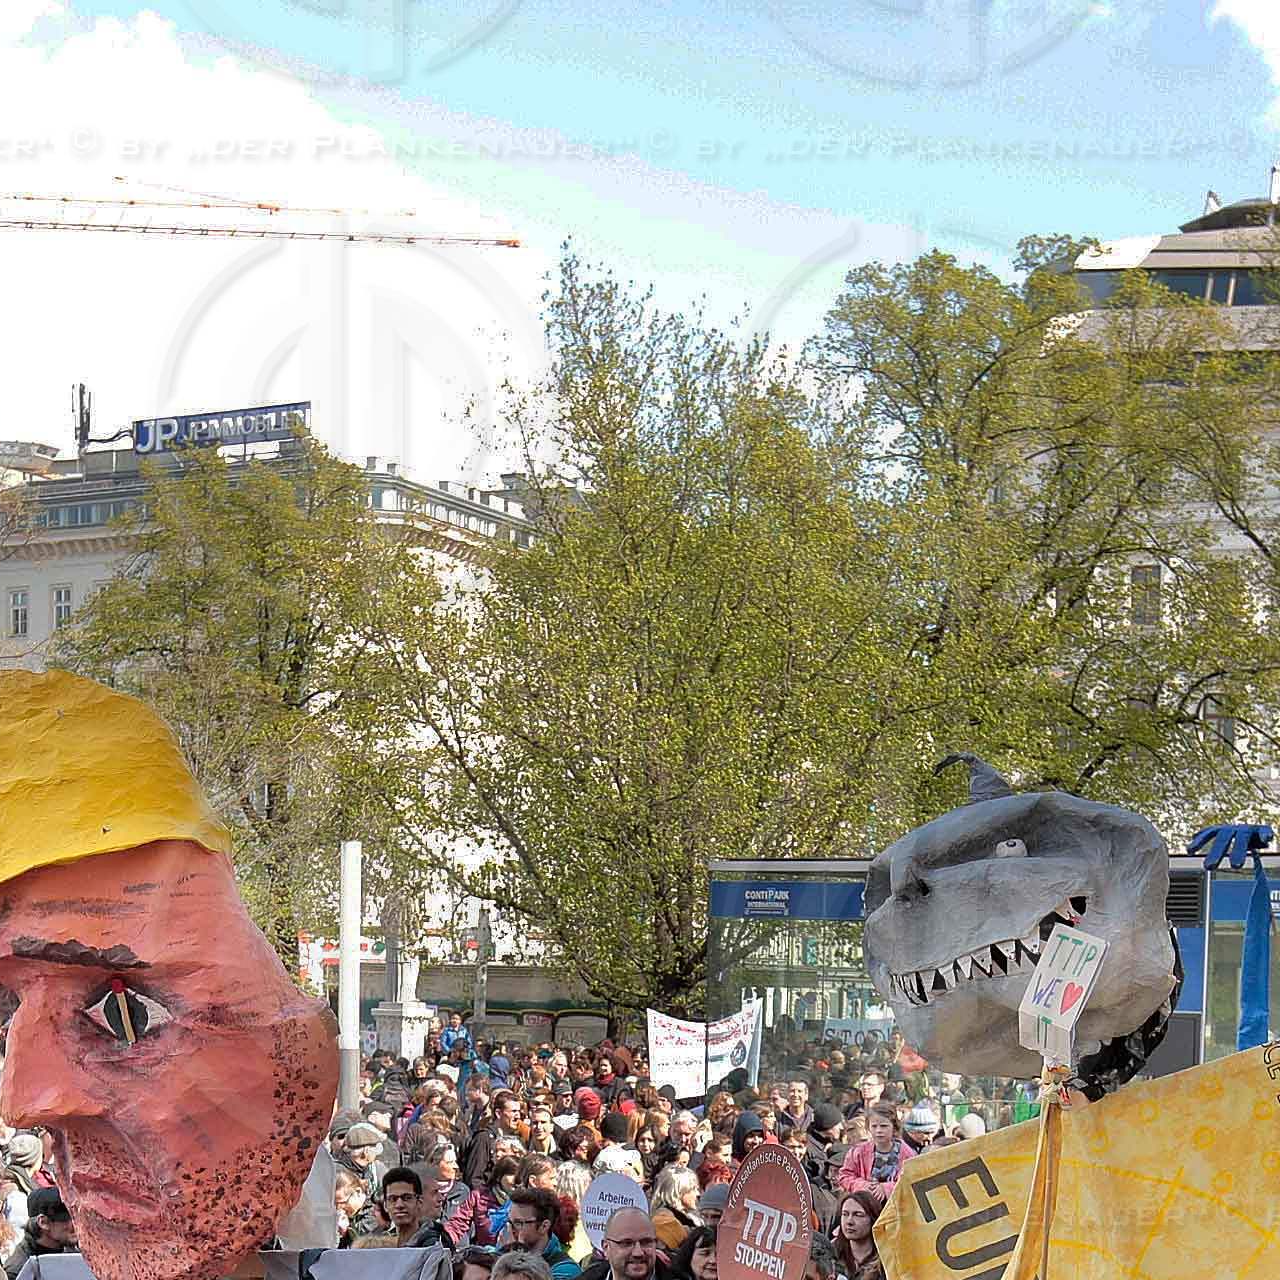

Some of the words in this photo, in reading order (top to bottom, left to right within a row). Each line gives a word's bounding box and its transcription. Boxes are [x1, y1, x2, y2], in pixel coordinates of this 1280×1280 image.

[744, 889, 790, 901] CONTIPARK
[1048, 933, 1098, 978] TTIP
[1031, 973, 1064, 1009] WE
[1036, 1015, 1053, 1050] IT
[586, 1206, 609, 1217] unter
[598, 1191, 635, 1207] Arbeiten
[728, 1151, 783, 1211] Transatlantische
[781, 1156, 811, 1241] Partnerschaft
[742, 1198, 799, 1254] TTIP
[734, 1242, 787, 1280] STOPPEN
